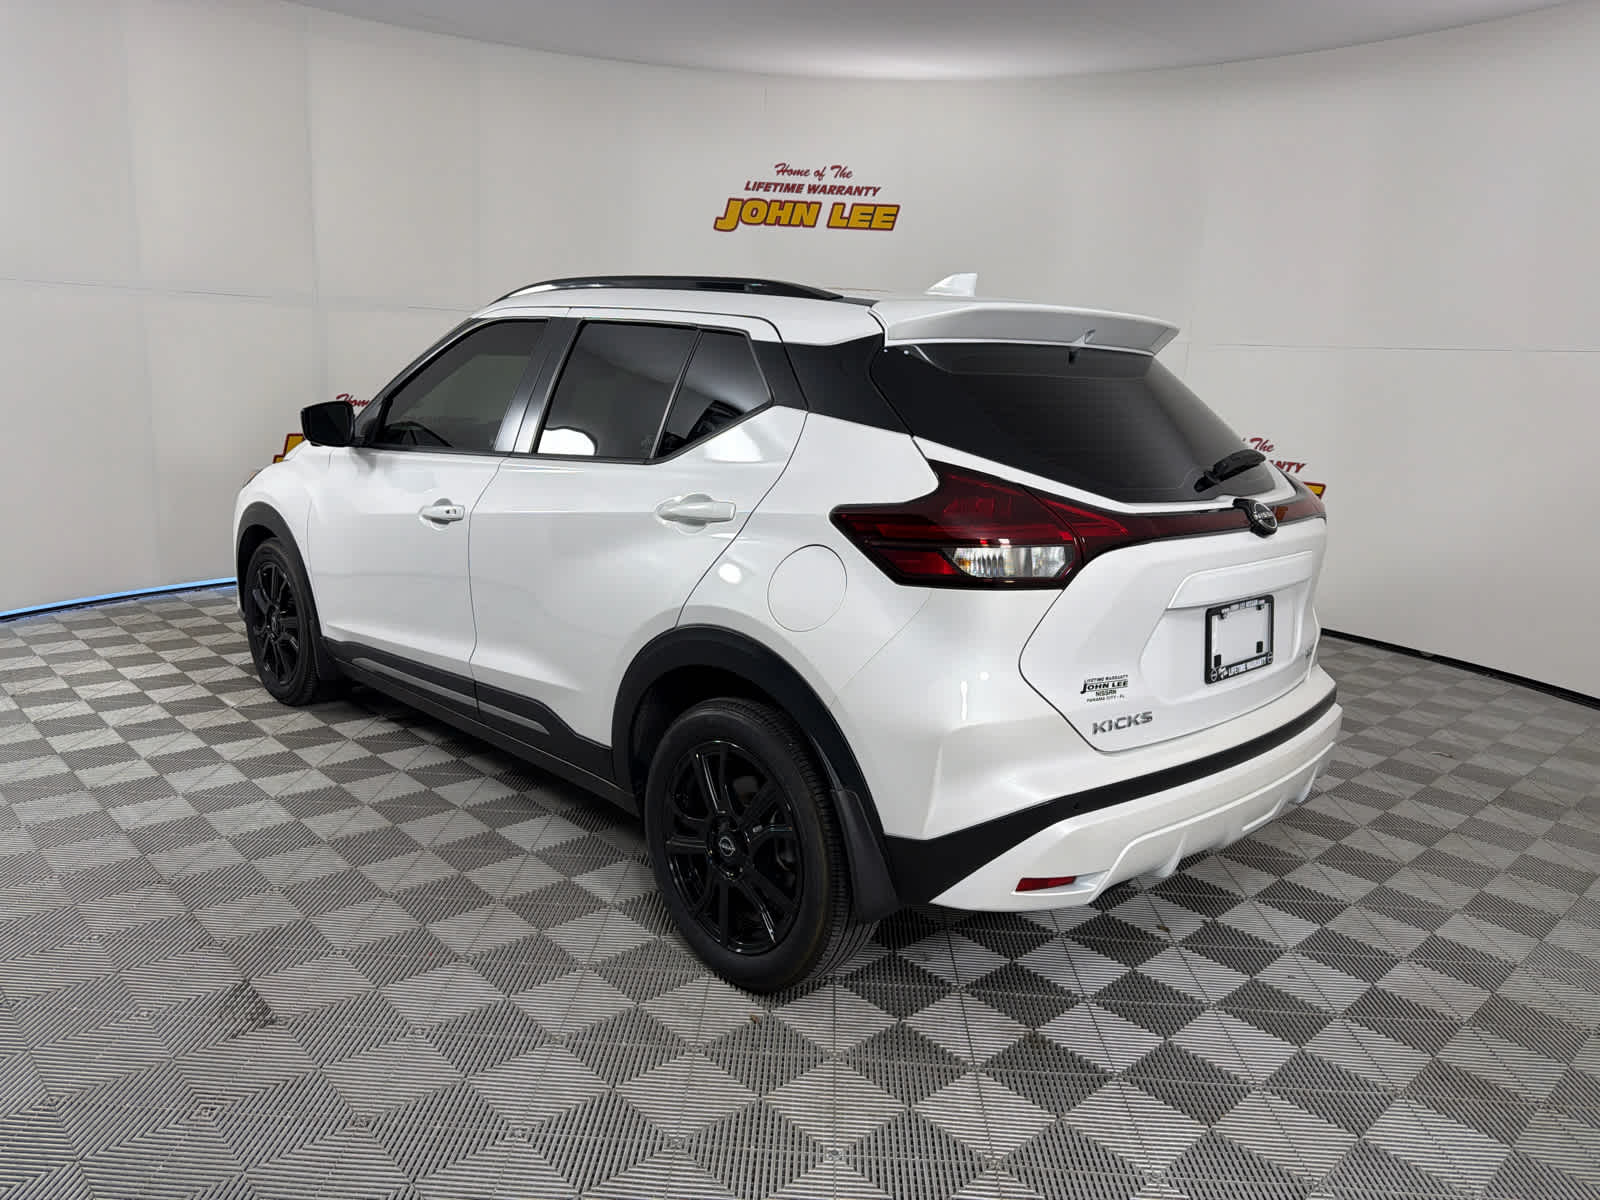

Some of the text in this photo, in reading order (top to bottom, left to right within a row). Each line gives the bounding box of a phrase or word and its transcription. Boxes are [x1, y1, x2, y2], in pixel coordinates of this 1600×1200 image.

[774, 162, 853, 181] Home of The
[744, 180, 882, 197] LIFETIME WARRANTY
[713, 197, 901, 232] JOHN LEE
[1249, 437, 1275, 453] The
[1080, 681, 1109, 694] JOHN
[1092, 711, 1153, 735] KICKS
